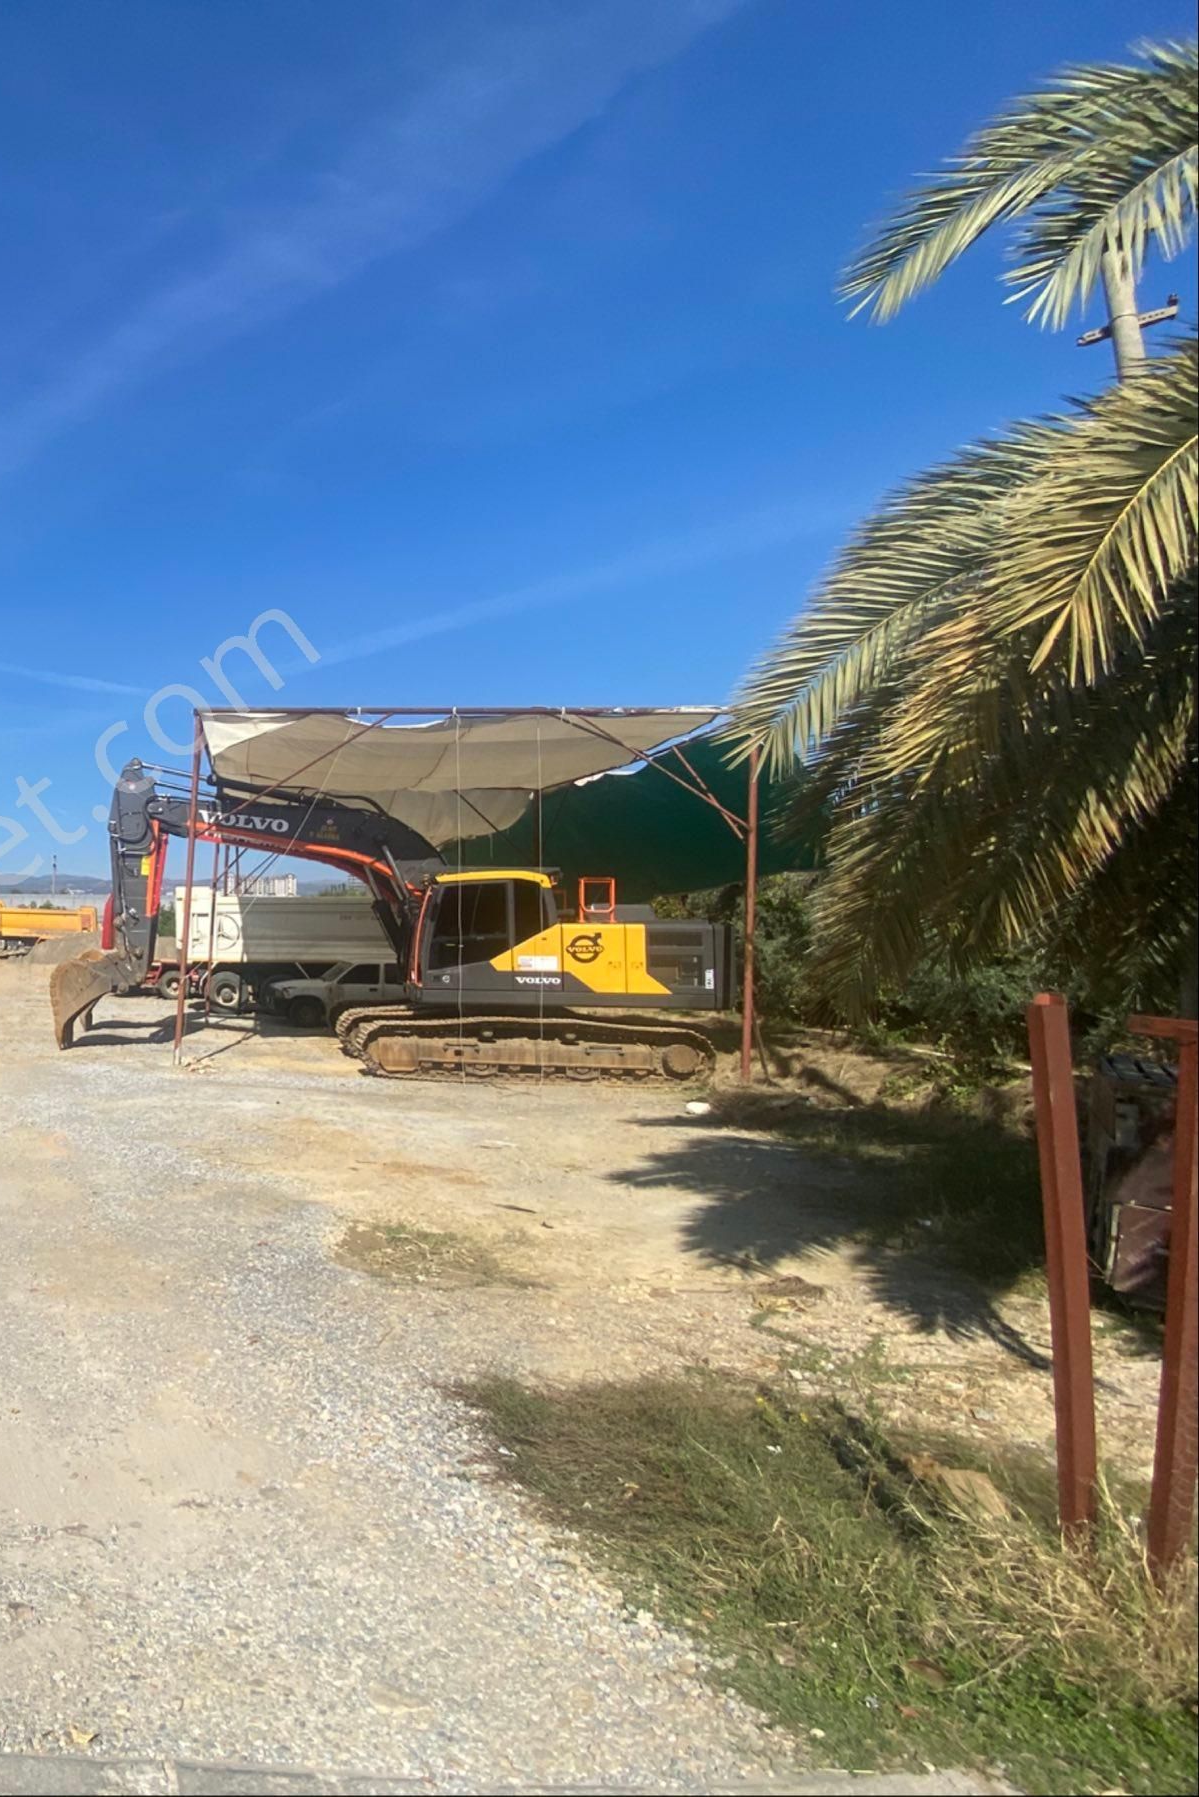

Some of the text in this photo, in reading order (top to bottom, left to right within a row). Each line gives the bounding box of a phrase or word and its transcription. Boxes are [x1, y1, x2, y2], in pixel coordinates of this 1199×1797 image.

[198, 809, 290, 833] VOLVO
[566, 945, 604, 953] VOLVO
[515, 976, 562, 985] VOLVO
